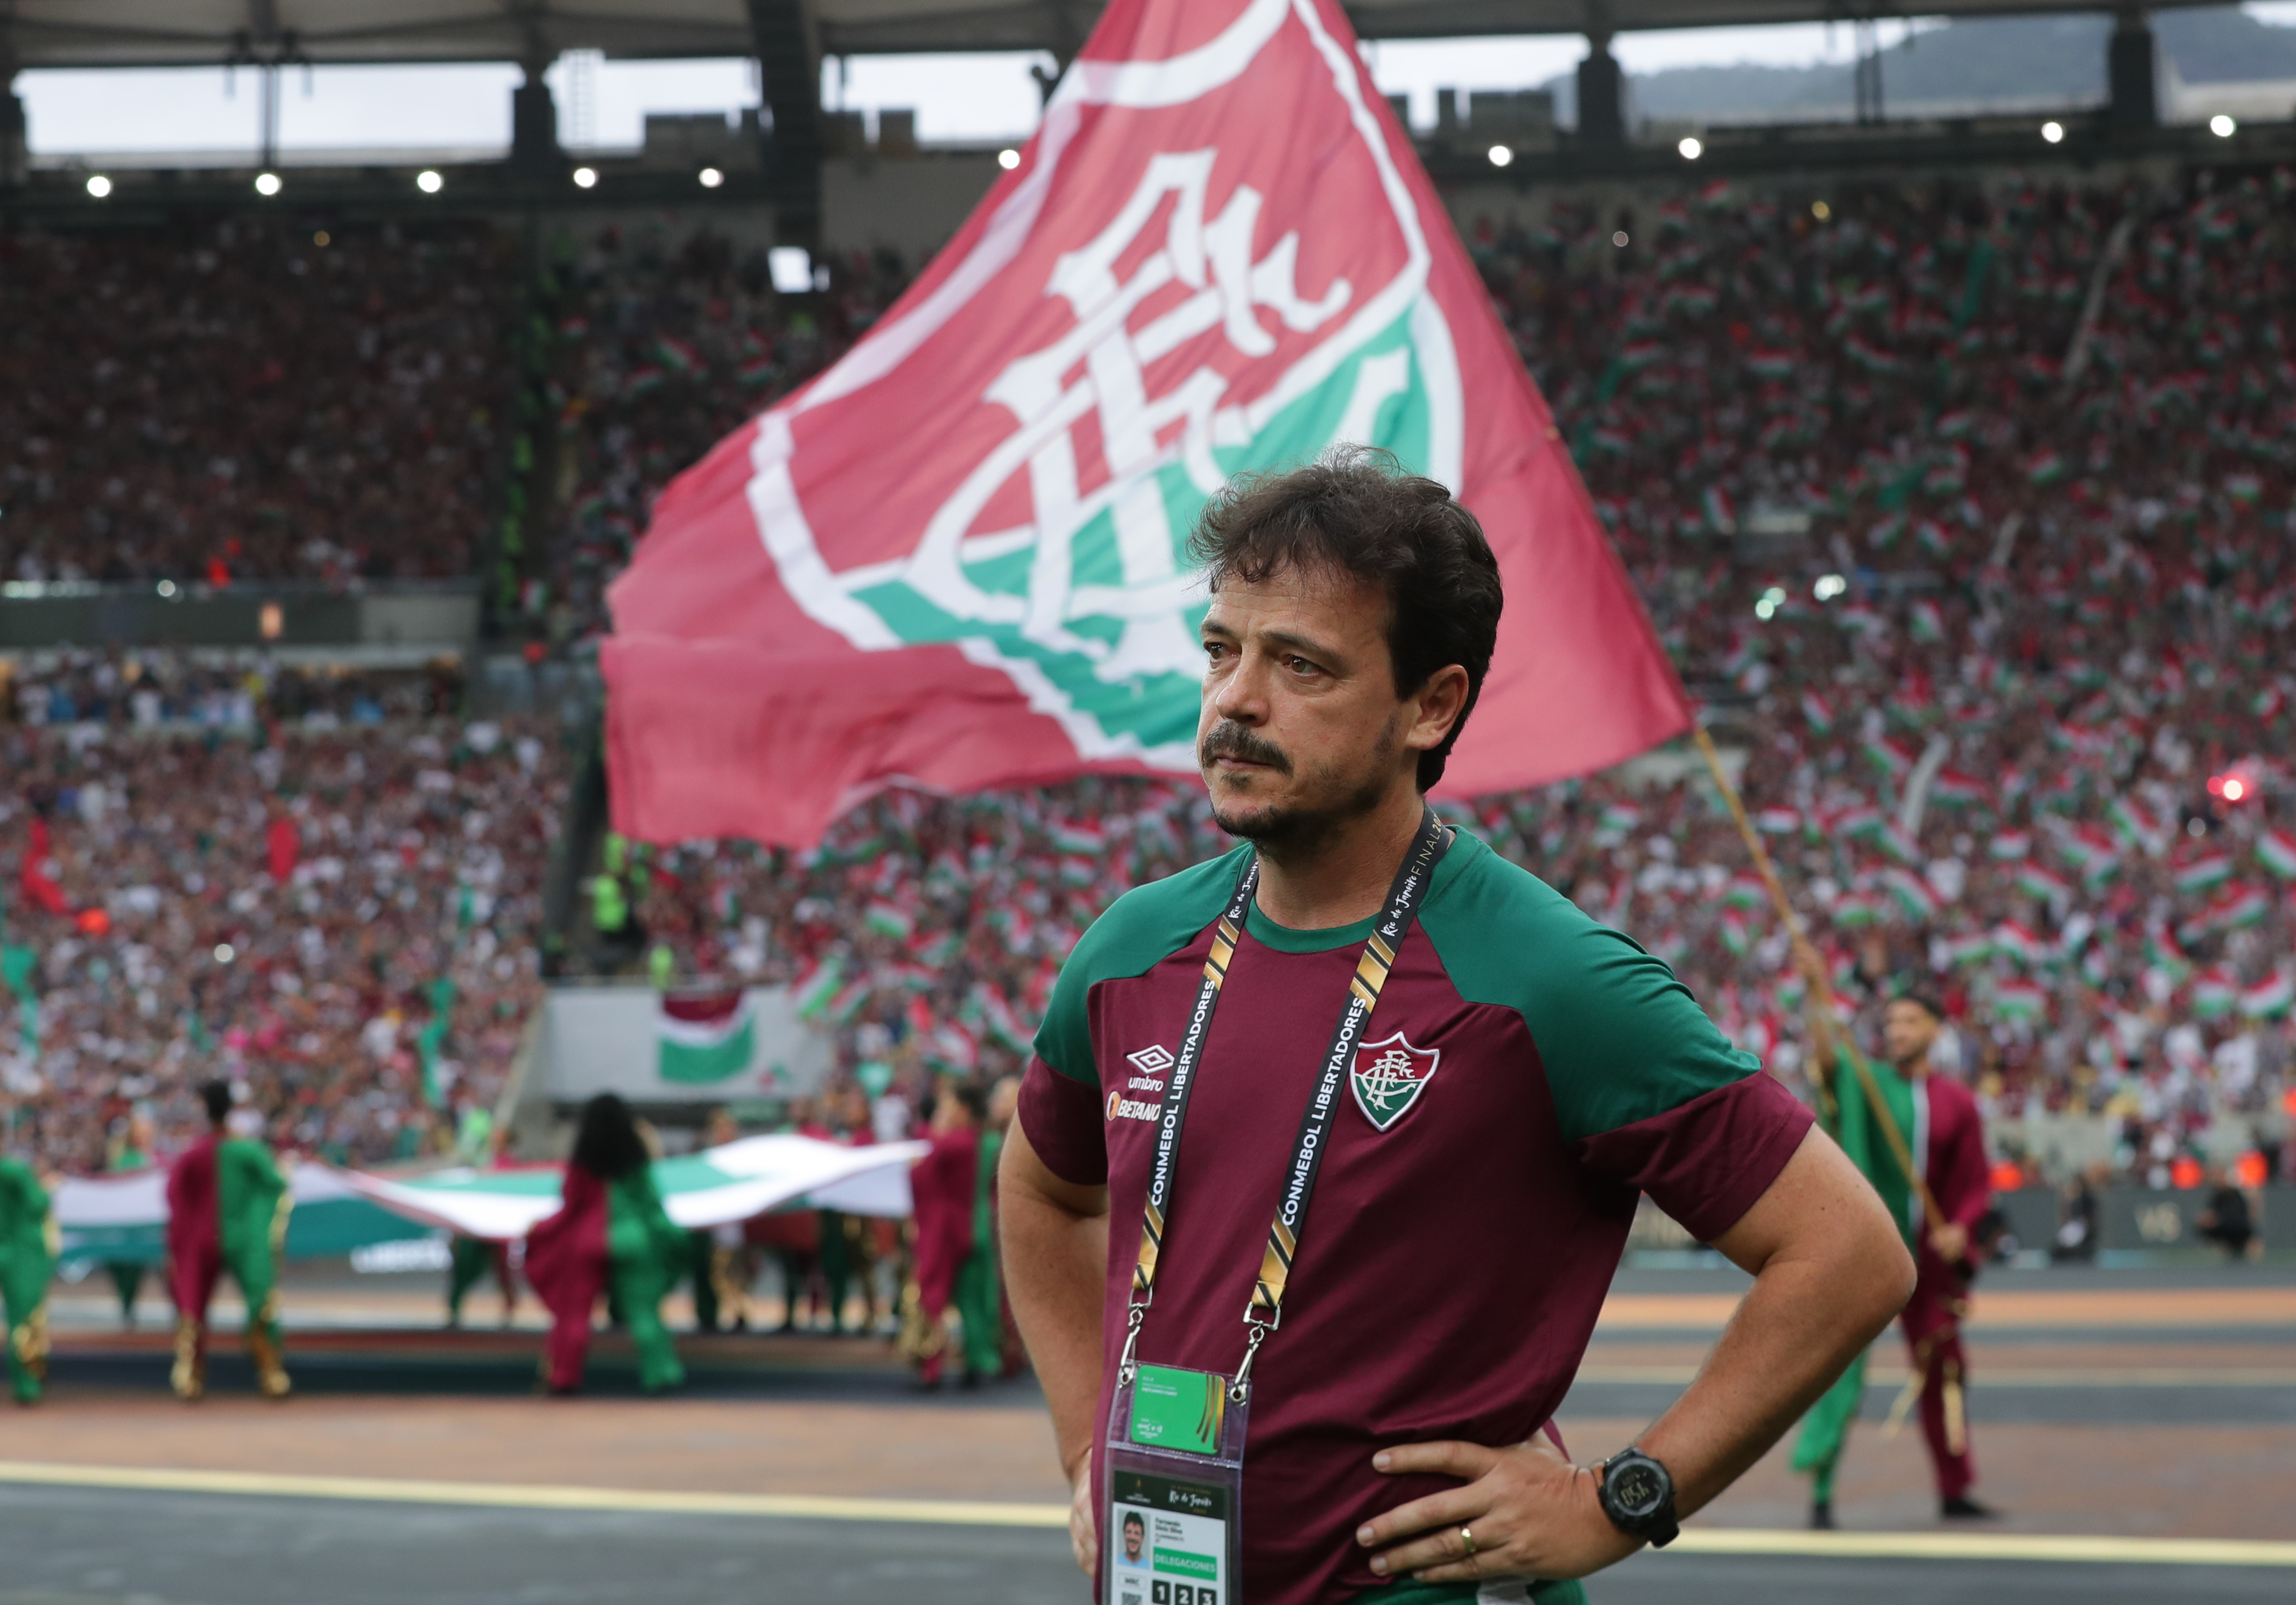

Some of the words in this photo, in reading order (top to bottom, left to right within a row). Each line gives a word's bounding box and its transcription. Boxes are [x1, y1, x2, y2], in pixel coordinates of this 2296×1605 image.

[1395, 875, 1417, 909] Janeiro
[1228, 905, 1242, 919] Rio
[1237, 893, 1245, 902] de
[1390, 907, 1402, 919] de
[1381, 921, 1398, 937] Rio
[1128, 1075, 1164, 1092] umbro
[1151, 1104, 1179, 1206] CONMEBOL
[1170, 980, 1215, 1100] LIBERTADORES
[1117, 1099, 1161, 1122] BETANO
[1282, 1125, 1322, 1226] CONMEBOL
[1311, 997, 1367, 1121] LIBERTADORES
[1155, 1553, 1216, 1573] DELEGACIONES
[1158, 1585, 1166, 1601] 1
[1178, 1588, 1189, 1605] 2
[1202, 1592, 1213, 1605] 3
